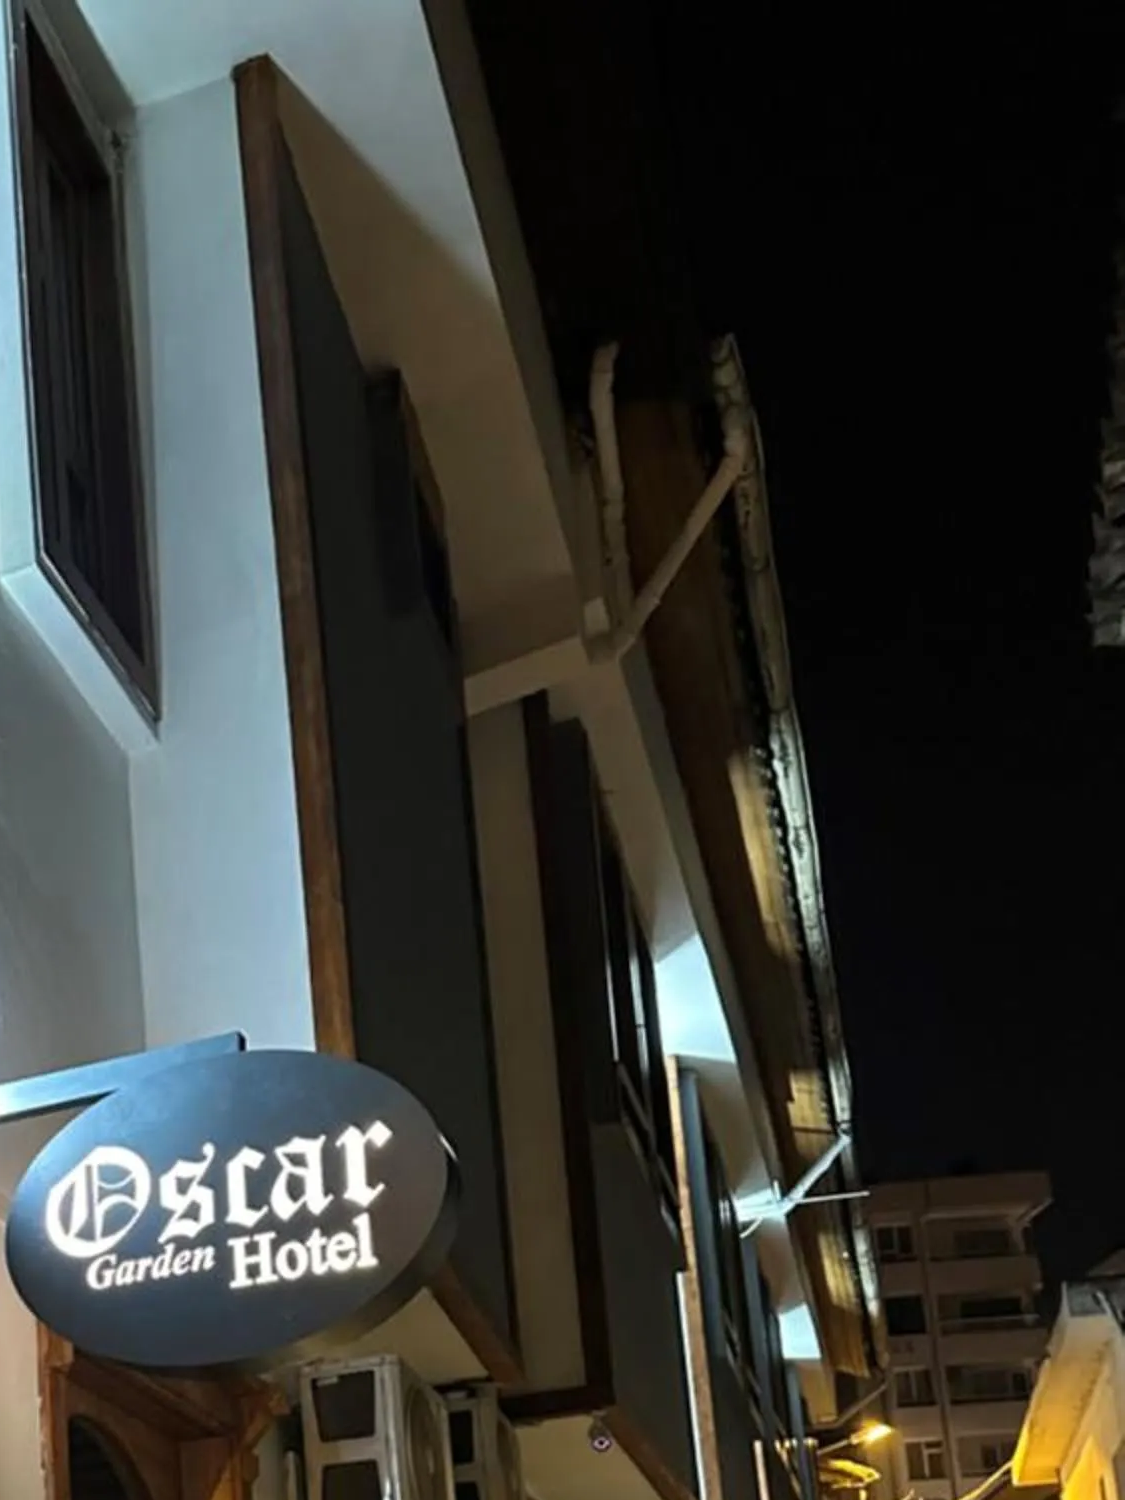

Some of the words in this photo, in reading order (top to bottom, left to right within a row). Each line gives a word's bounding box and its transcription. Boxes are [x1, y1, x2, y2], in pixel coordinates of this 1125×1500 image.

[44, 1119, 394, 1259] Oscar
[85, 1242, 216, 1291] Garden
[226, 1212, 379, 1290] Hotel
